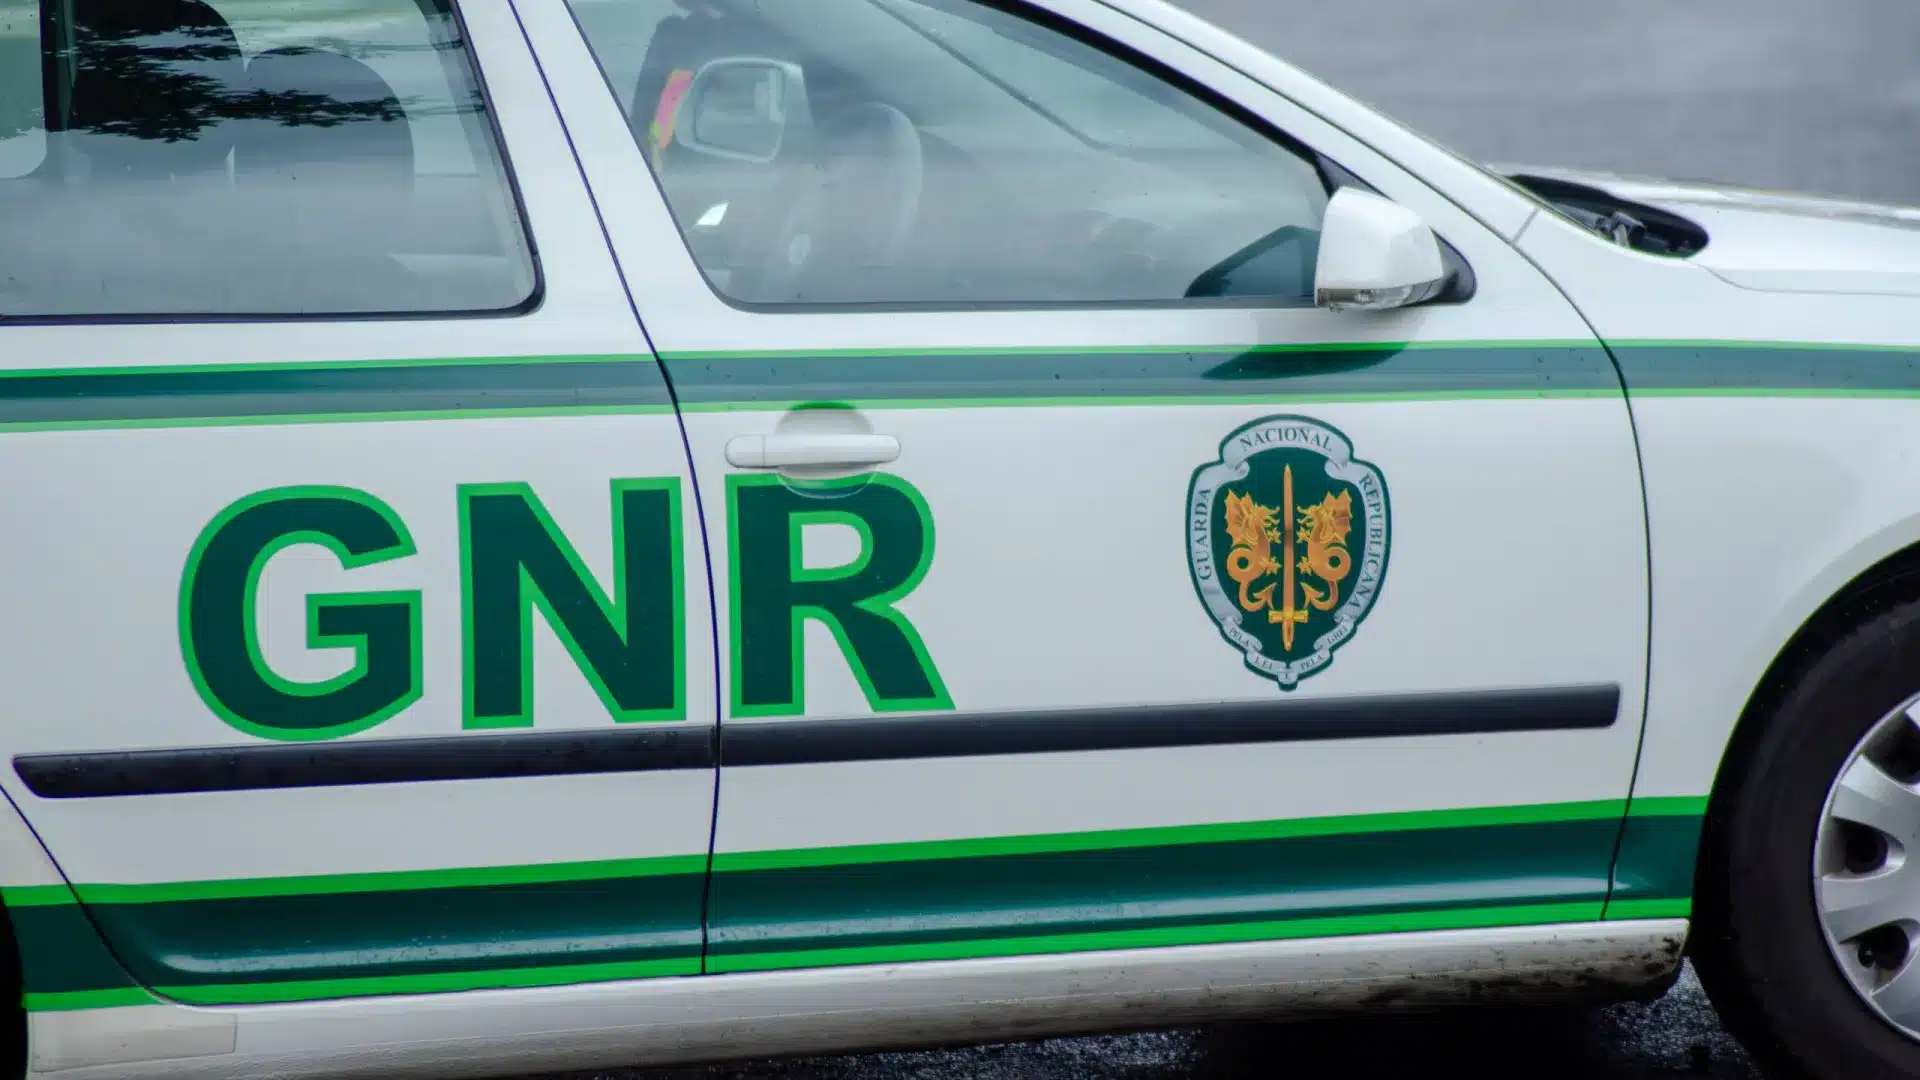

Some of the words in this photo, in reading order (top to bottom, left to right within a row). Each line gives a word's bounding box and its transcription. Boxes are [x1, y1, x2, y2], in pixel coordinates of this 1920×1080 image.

[1240, 427, 1332, 452] NACIONAL
[1194, 488, 1213, 581] GUARDA
[1348, 473, 1383, 610] REPUBLICANA
[177, 472, 956, 742] GNR
[1229, 627, 1251, 647] PELA
[1254, 655, 1273, 670] LEI
[1300, 654, 1324, 670] PELA
